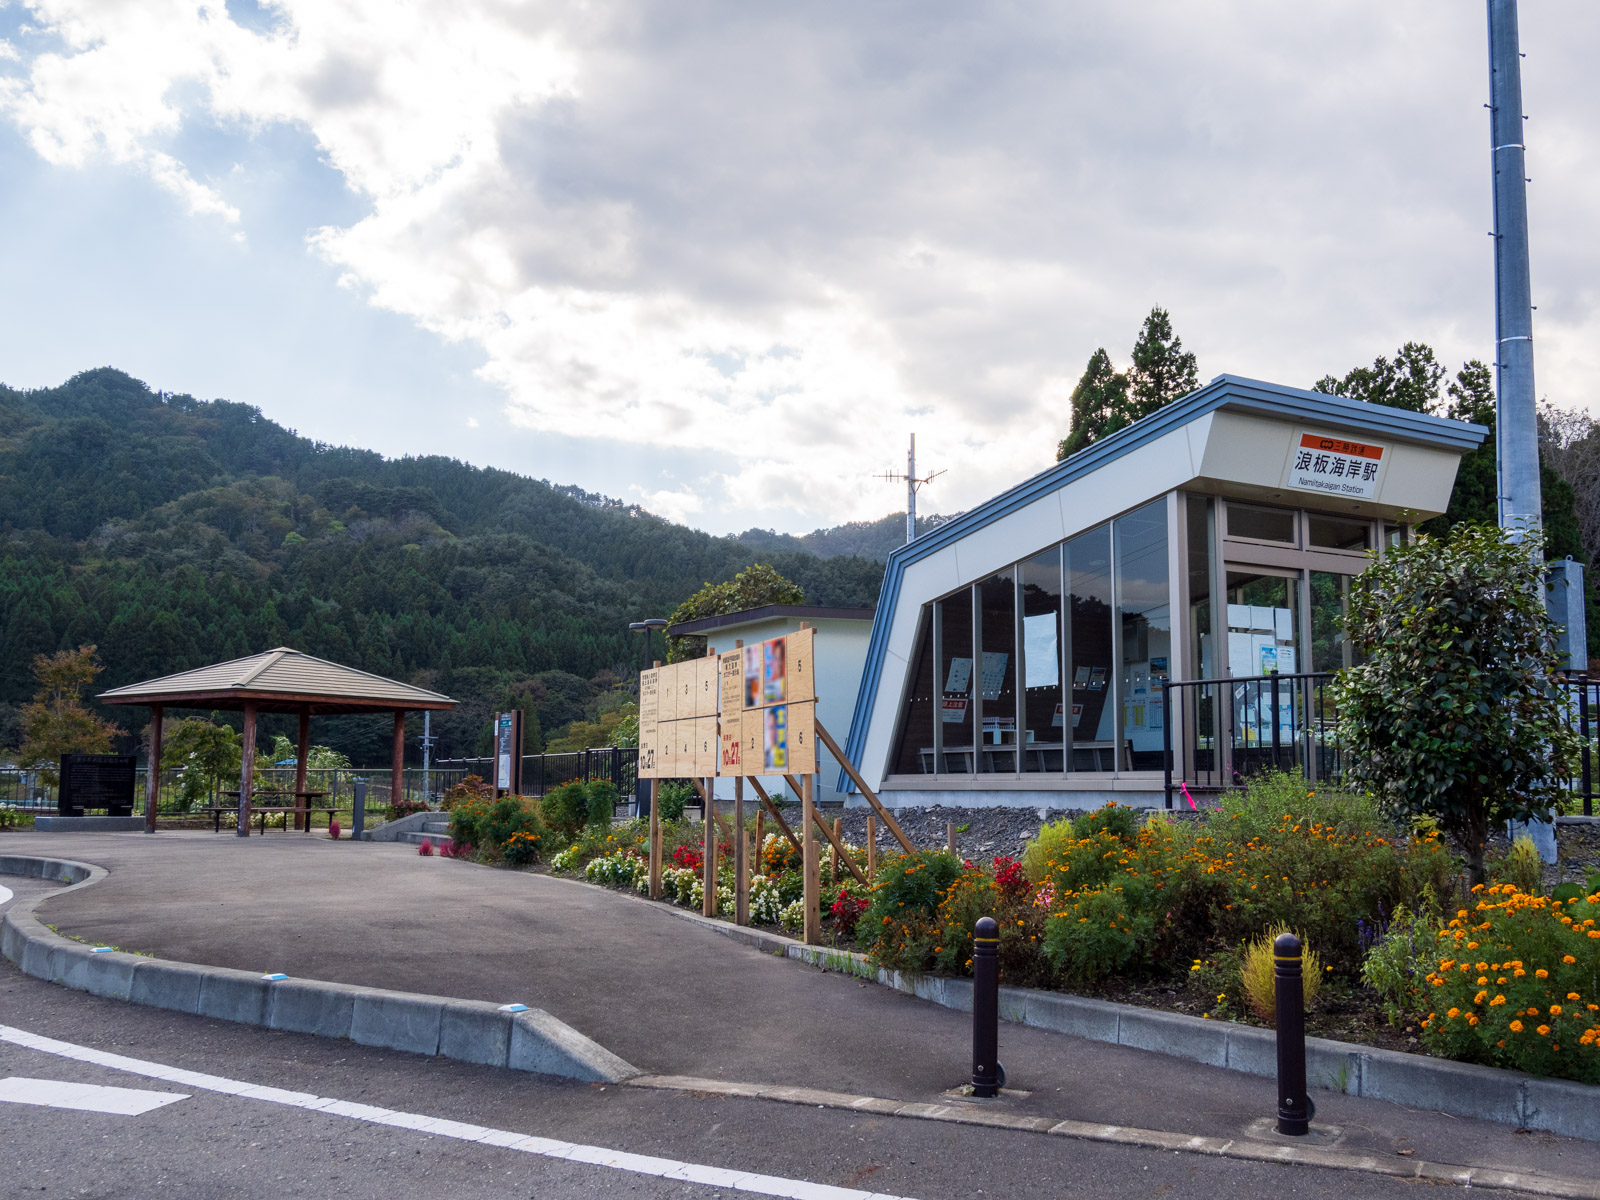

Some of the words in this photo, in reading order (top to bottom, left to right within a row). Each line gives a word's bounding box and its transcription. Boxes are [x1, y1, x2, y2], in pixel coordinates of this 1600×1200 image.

[1295, 450, 1378, 482] 浪板海岸駅
[1298, 477, 1341, 491] Namiitakaigan
[1341, 483, 1364, 495] Station
[798, 660, 802, 673] 5
[751, 737, 755, 749] 2
[799, 732, 803, 745] 6
